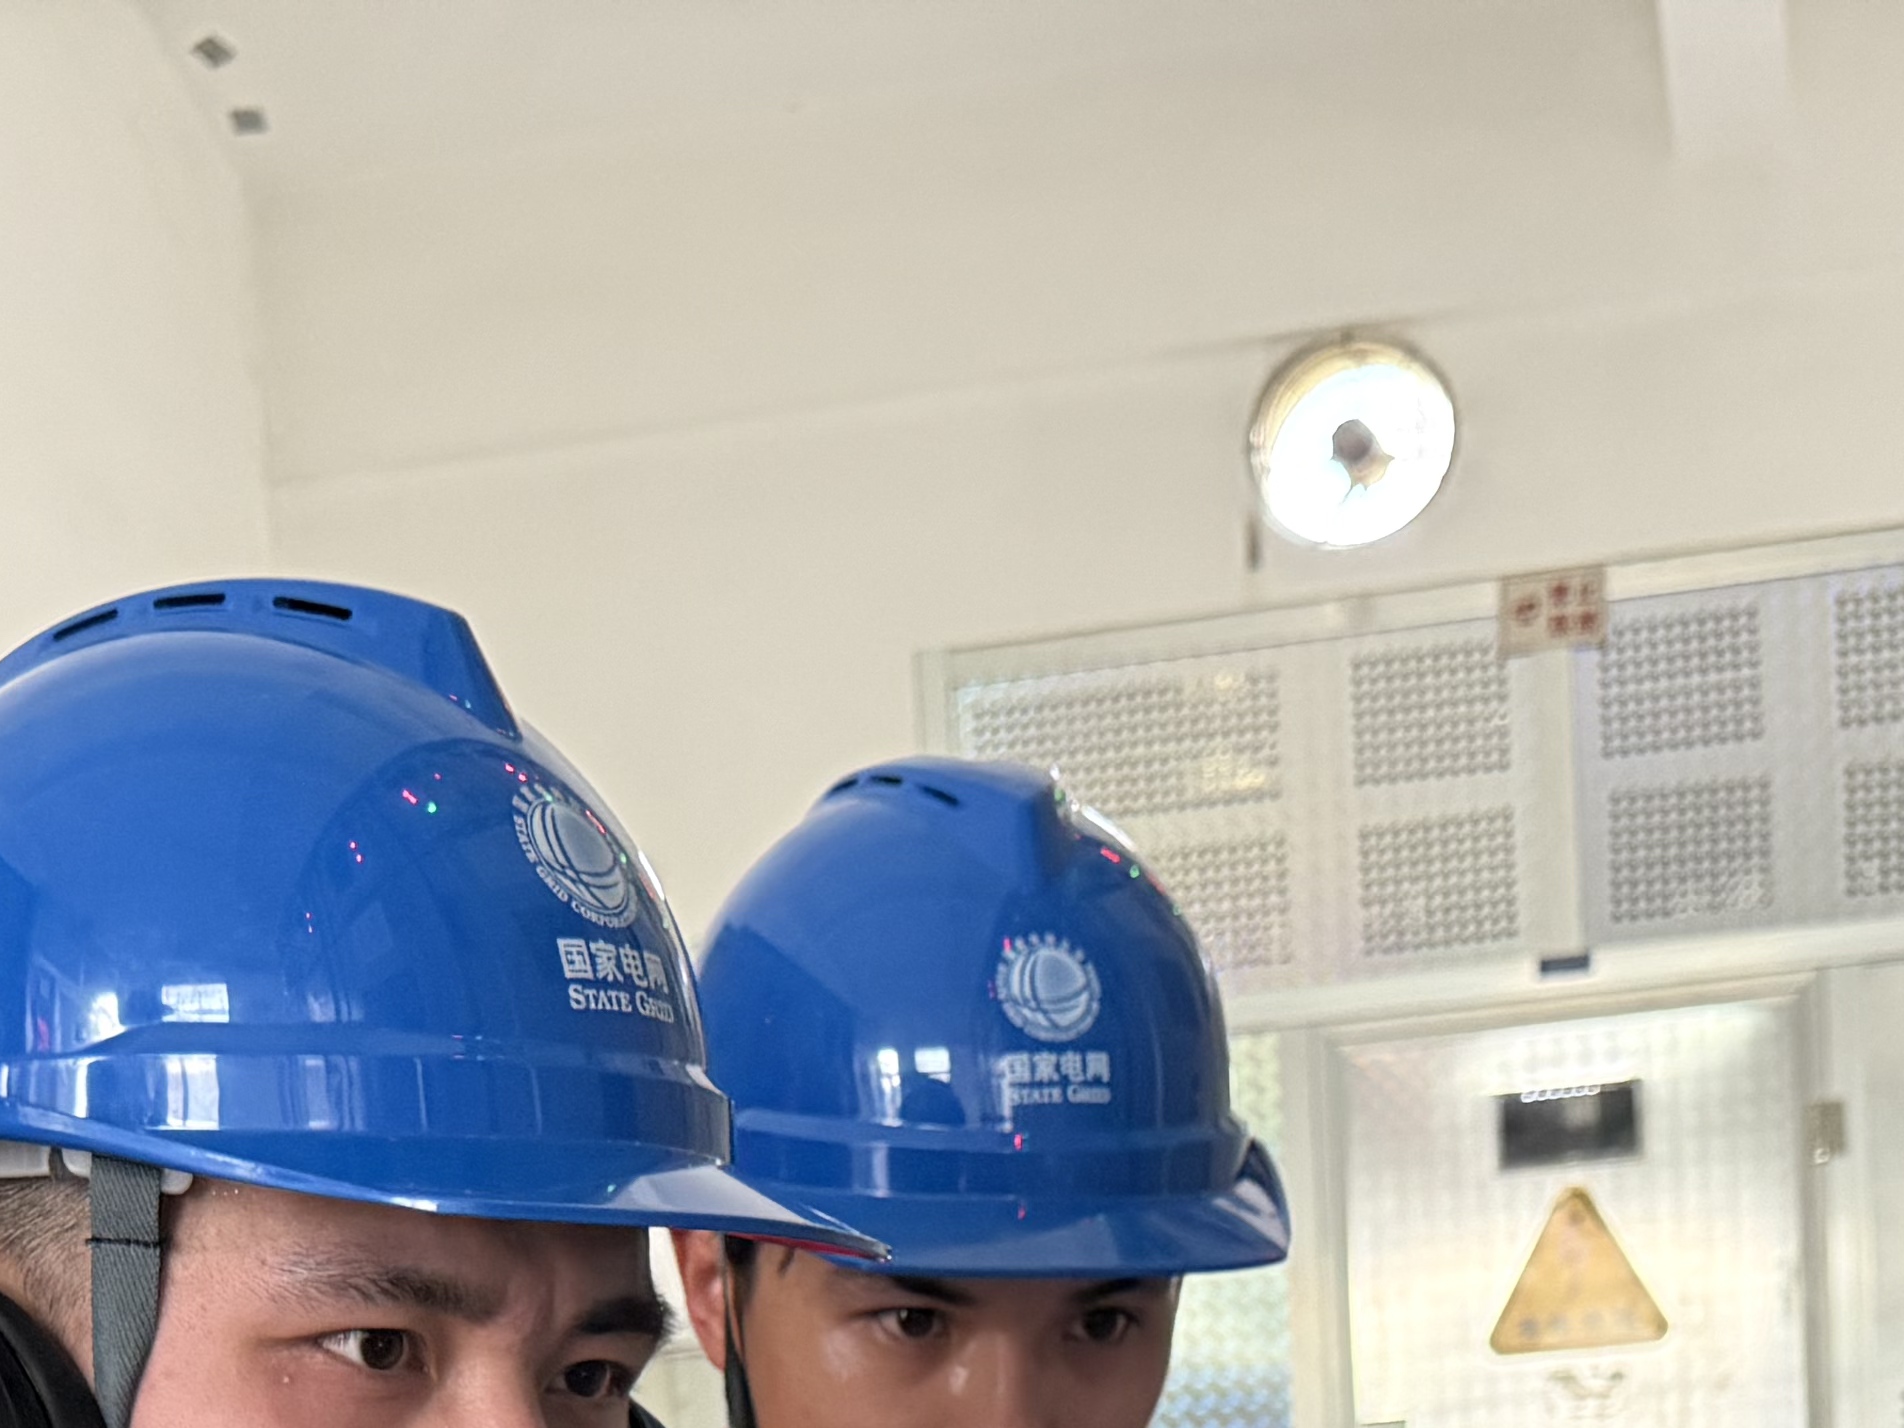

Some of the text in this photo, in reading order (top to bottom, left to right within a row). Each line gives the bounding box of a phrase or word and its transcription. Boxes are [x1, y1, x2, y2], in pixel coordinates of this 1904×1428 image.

[556, 937, 670, 995] 国家电网
[568, 983, 633, 1013] STATE
[1006, 1051, 1111, 1084] 国家电网
